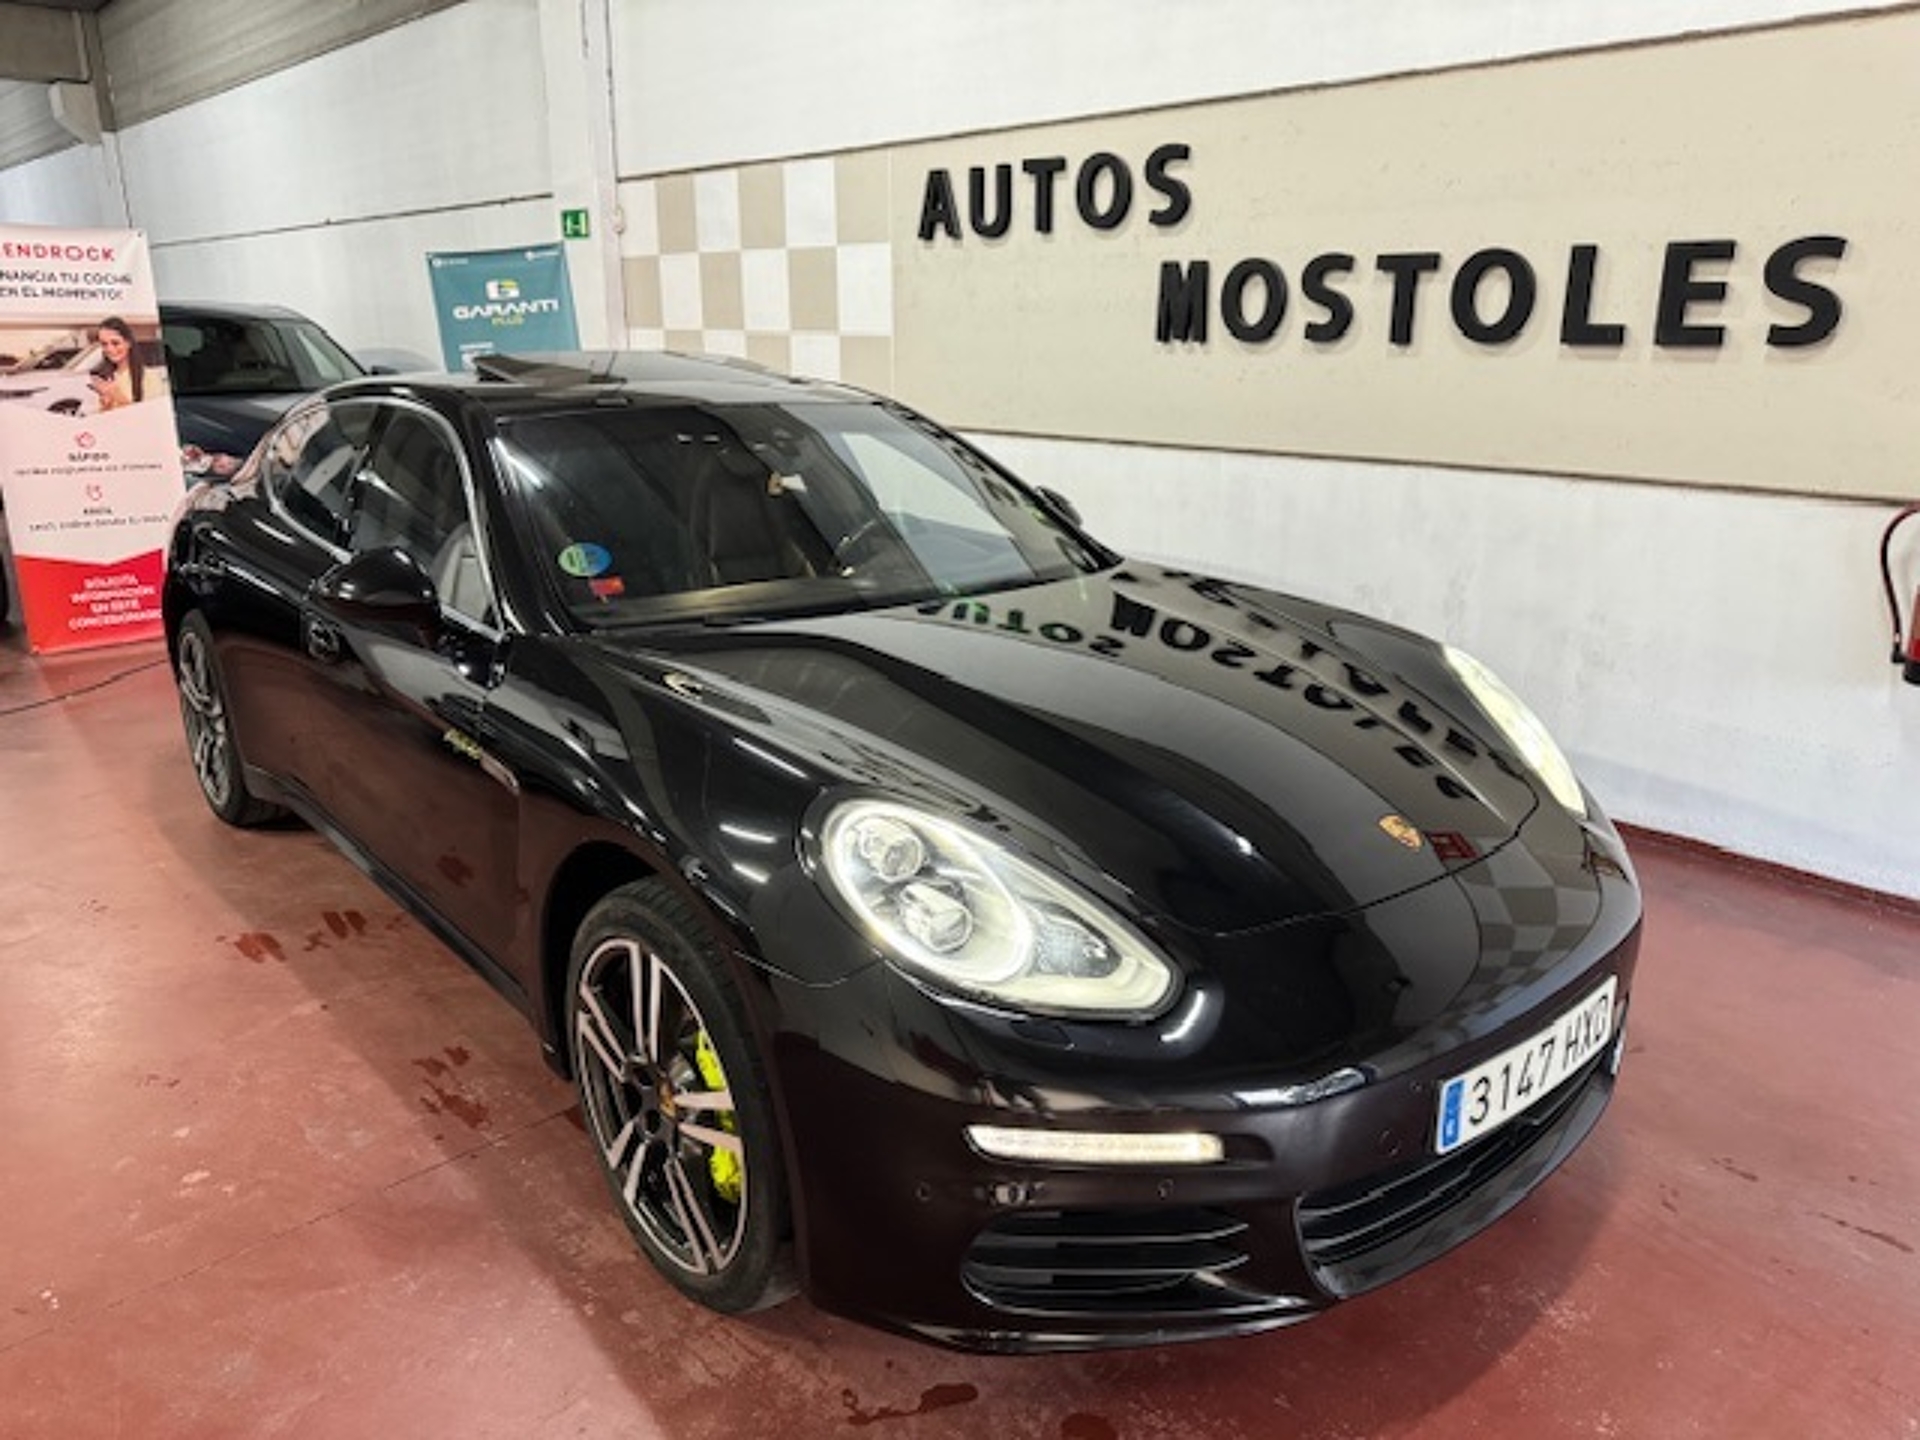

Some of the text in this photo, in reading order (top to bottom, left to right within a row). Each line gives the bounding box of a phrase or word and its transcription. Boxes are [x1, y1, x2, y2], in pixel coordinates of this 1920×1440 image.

[918, 143, 1192, 241] AUTOS
[0, 243, 115, 262] ENDROCK
[60, 272, 79, 284] TU
[453, 299, 560, 320] GARANTI
[1156, 236, 1847, 348] MOSTOLES
[1469, 1037, 1556, 1126] 3147
